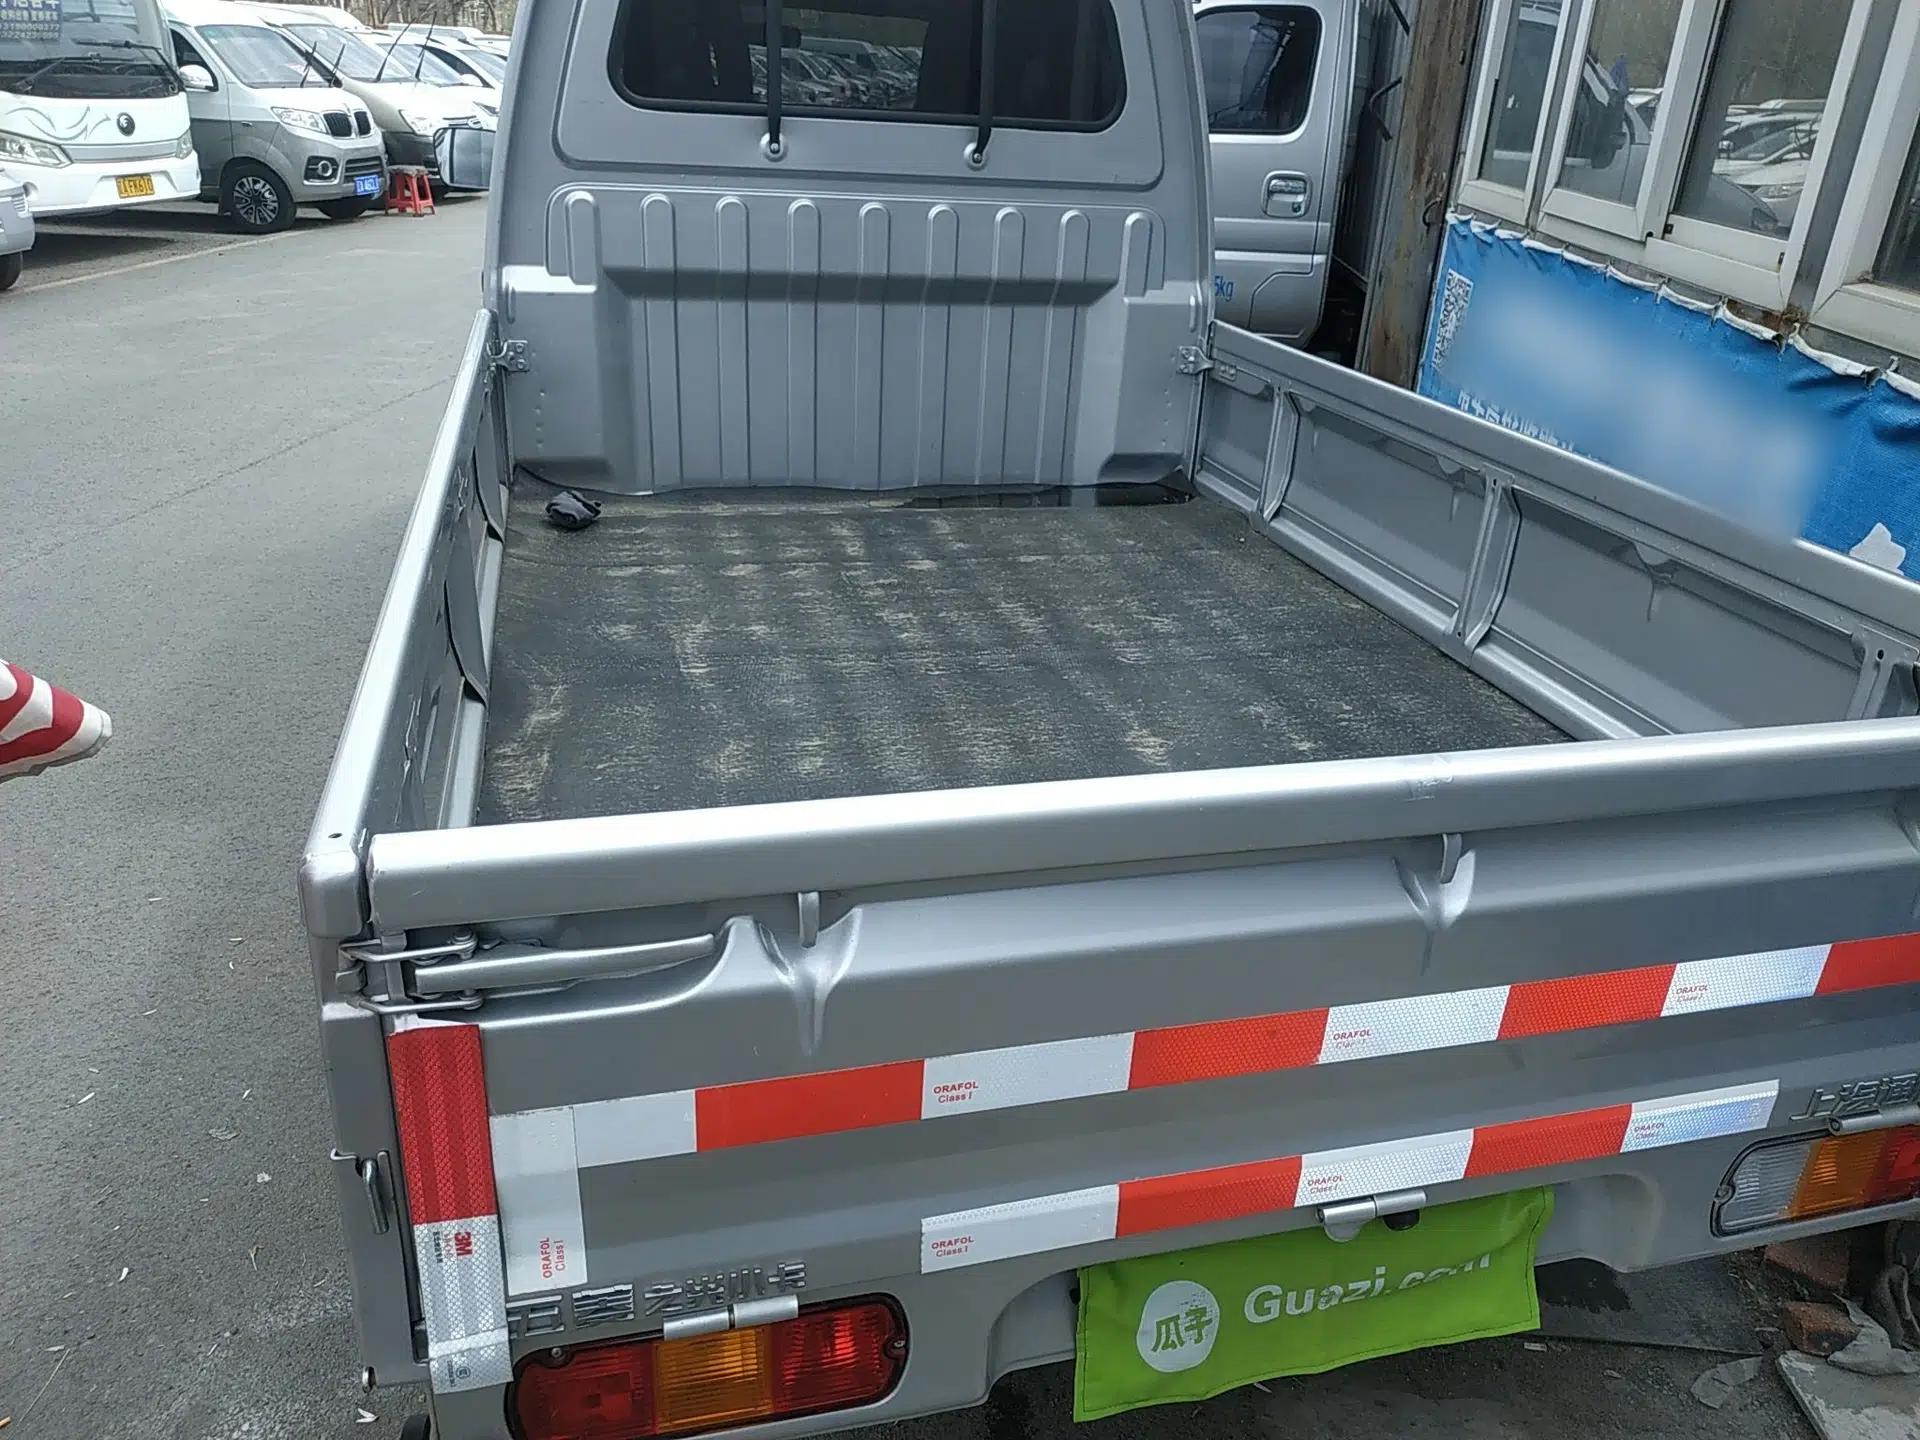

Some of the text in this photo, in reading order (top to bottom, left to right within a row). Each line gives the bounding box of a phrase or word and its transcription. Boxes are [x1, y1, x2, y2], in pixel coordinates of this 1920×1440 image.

[1333, 1029, 1372, 1041] ORAFOL
[933, 1081, 979, 1095] ORAFOL
[938, 1093, 967, 1104] Class
[1634, 1122, 1665, 1132] ORAFOL
[1307, 1174, 1345, 1186] ORAFOL
[454, 1231, 473, 1257] 3M
[931, 1235, 975, 1249] ORAFOL
[540, 1236, 552, 1279] ORAFOL
[554, 1244, 566, 1271] Class
[936, 1247, 963, 1257] Class
[504, 1262, 806, 1338] 五菱之光小卡
[1151, 1303, 1214, 1353] 瓜子
